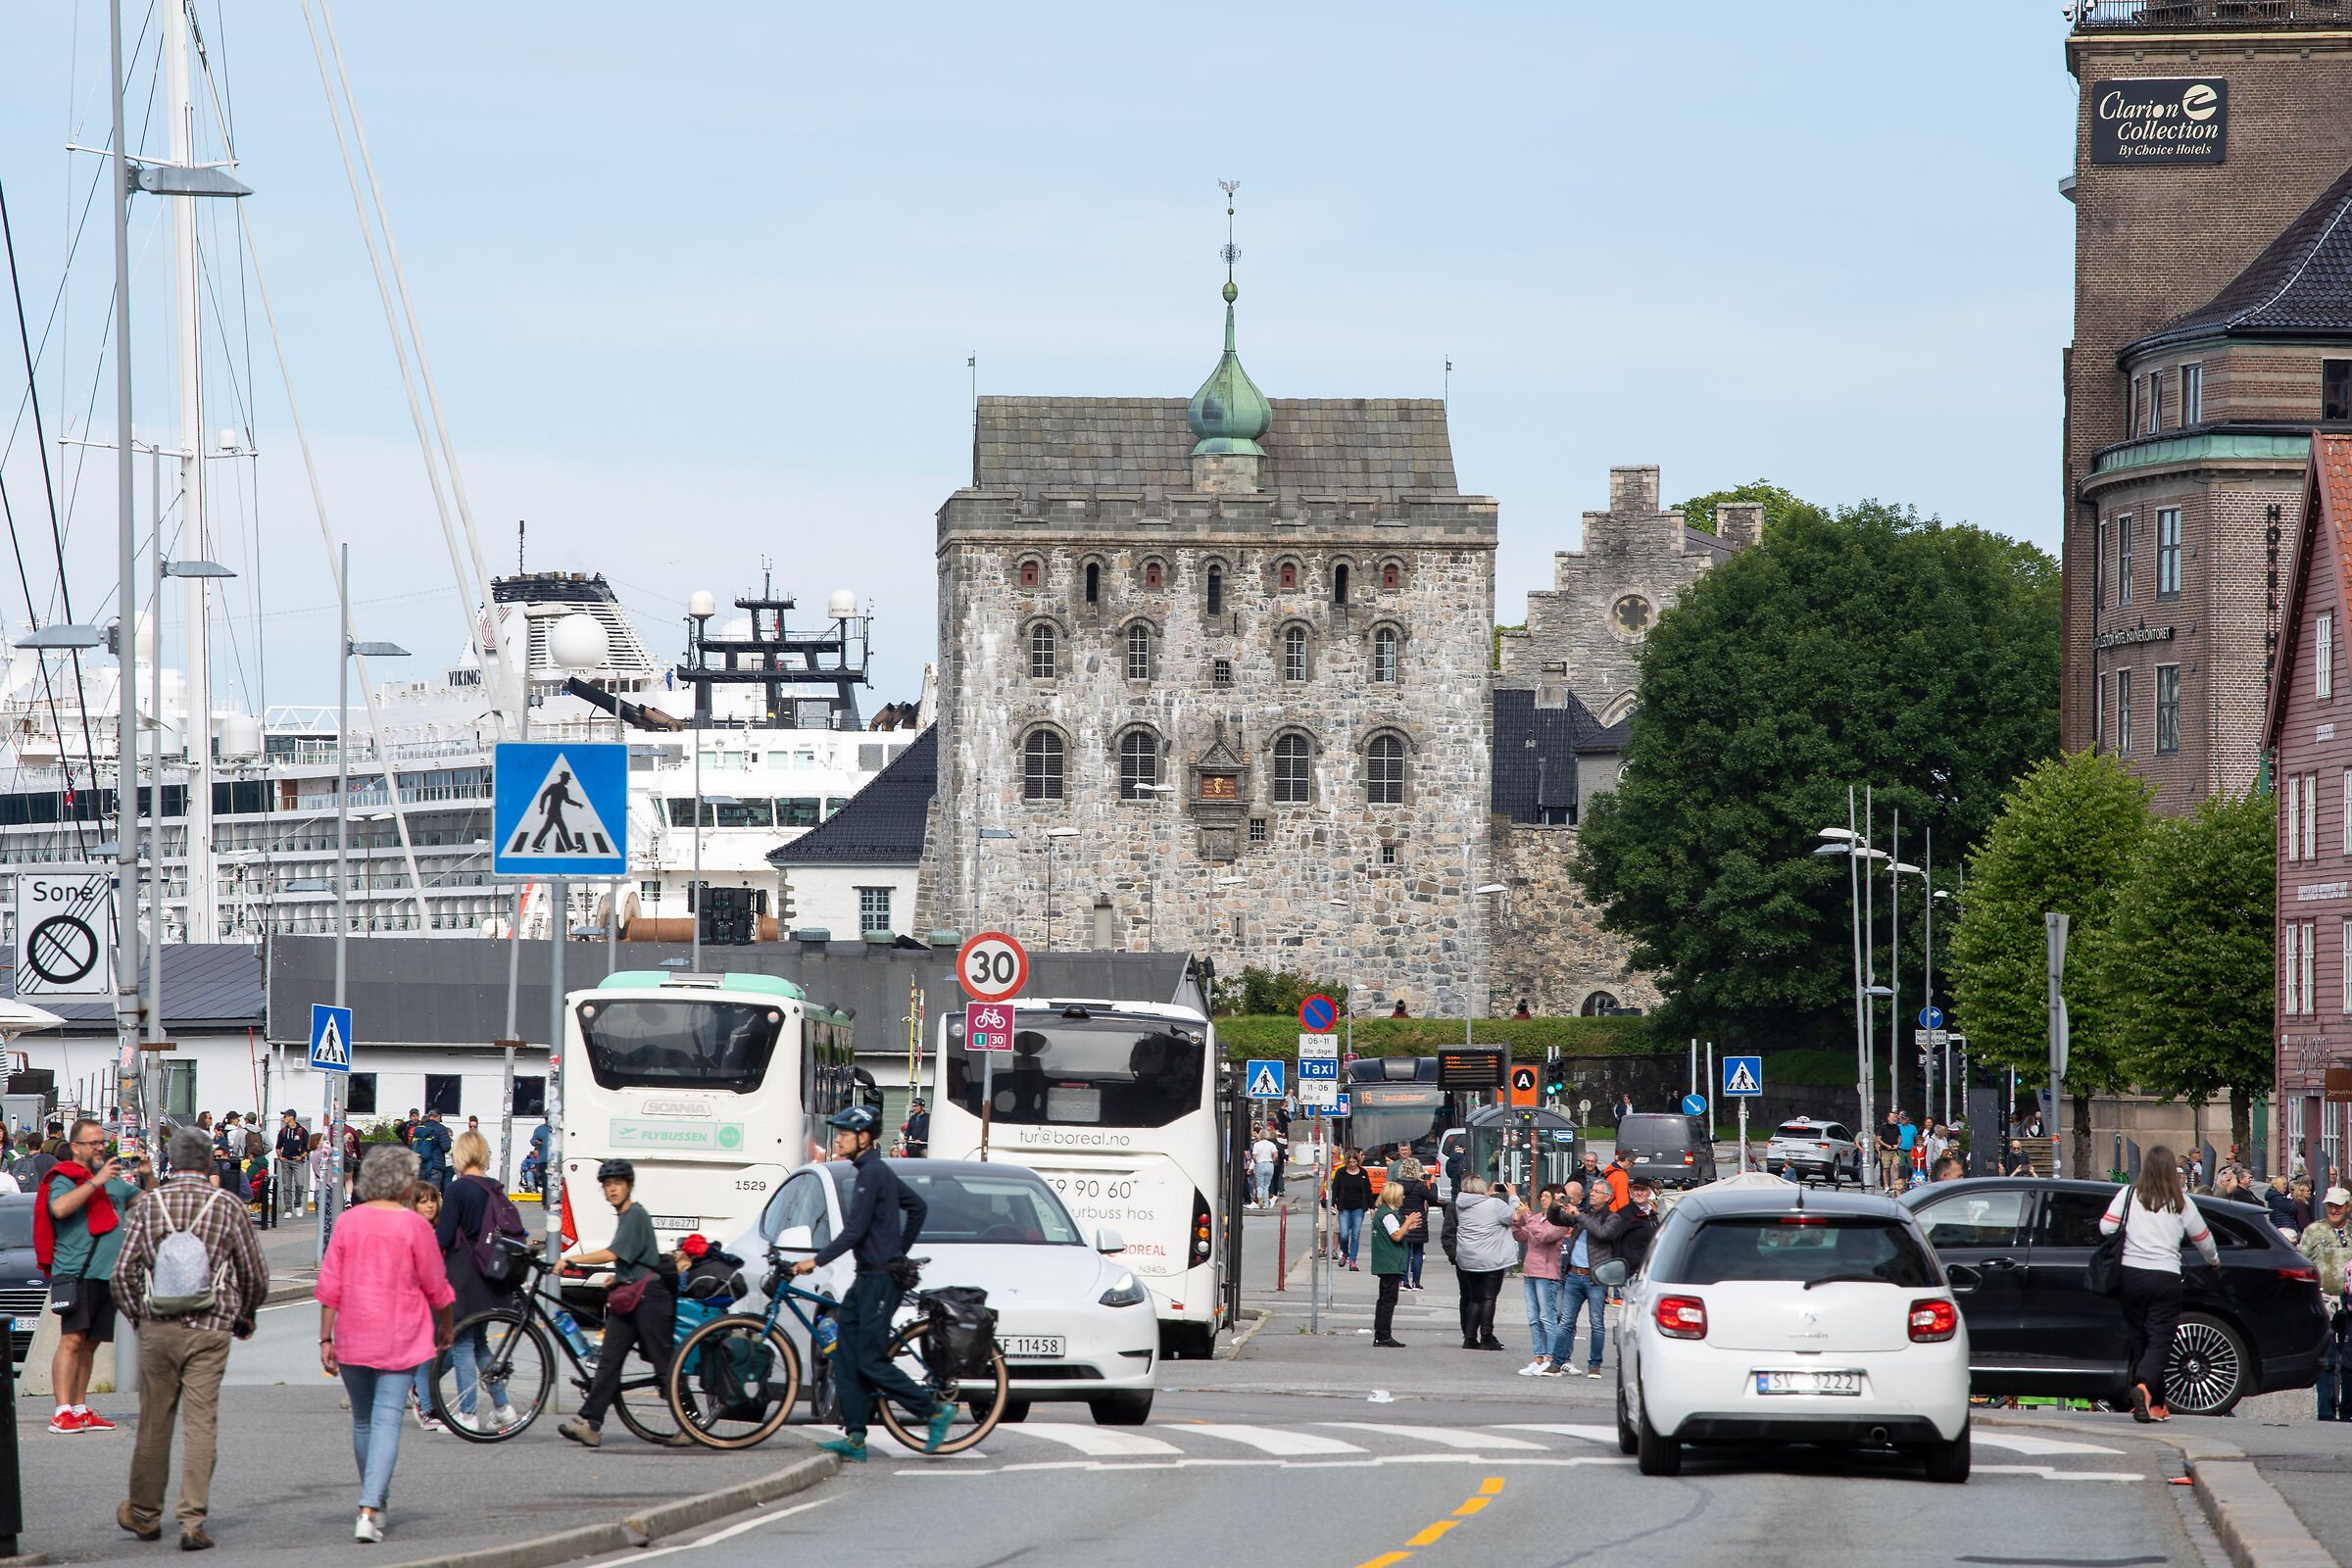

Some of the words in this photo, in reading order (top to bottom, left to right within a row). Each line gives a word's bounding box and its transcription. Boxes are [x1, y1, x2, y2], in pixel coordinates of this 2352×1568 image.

[2099, 90, 2179, 120] Clarion
[2117, 120, 2219, 140] Collection
[2119, 144, 2133, 158] By
[2134, 144, 2174, 156] Choice
[2176, 143, 2212, 155] Hotels
[2267, 504, 2281, 610] HOTEL
[448, 668, 481, 687] VIKING
[32, 881, 93, 902] Sone
[971, 950, 1014, 984] 30
[978, 1035, 983, 1045] 1
[991, 1035, 1004, 1045] 30
[1303, 1062, 1334, 1074] Taxi
[1517, 1073, 1531, 1088] A
[1360, 1091, 1372, 1104] 19
[648, 1102, 707, 1114] SCANIA
[641, 1130, 708, 1143] FLYBUSSEN
[1019, 1130, 1130, 1147] tur@boreal.no
[735, 1180, 766, 1191] 1529
[1076, 1180, 1100, 1197] 90
[1108, 1181, 1131, 1199] 60
[1127, 1207, 1153, 1220] hos
[669, 1219, 696, 1228] 86271
[1017, 1339, 1057, 1352] 11458
[1773, 1373, 1793, 1389] SV
